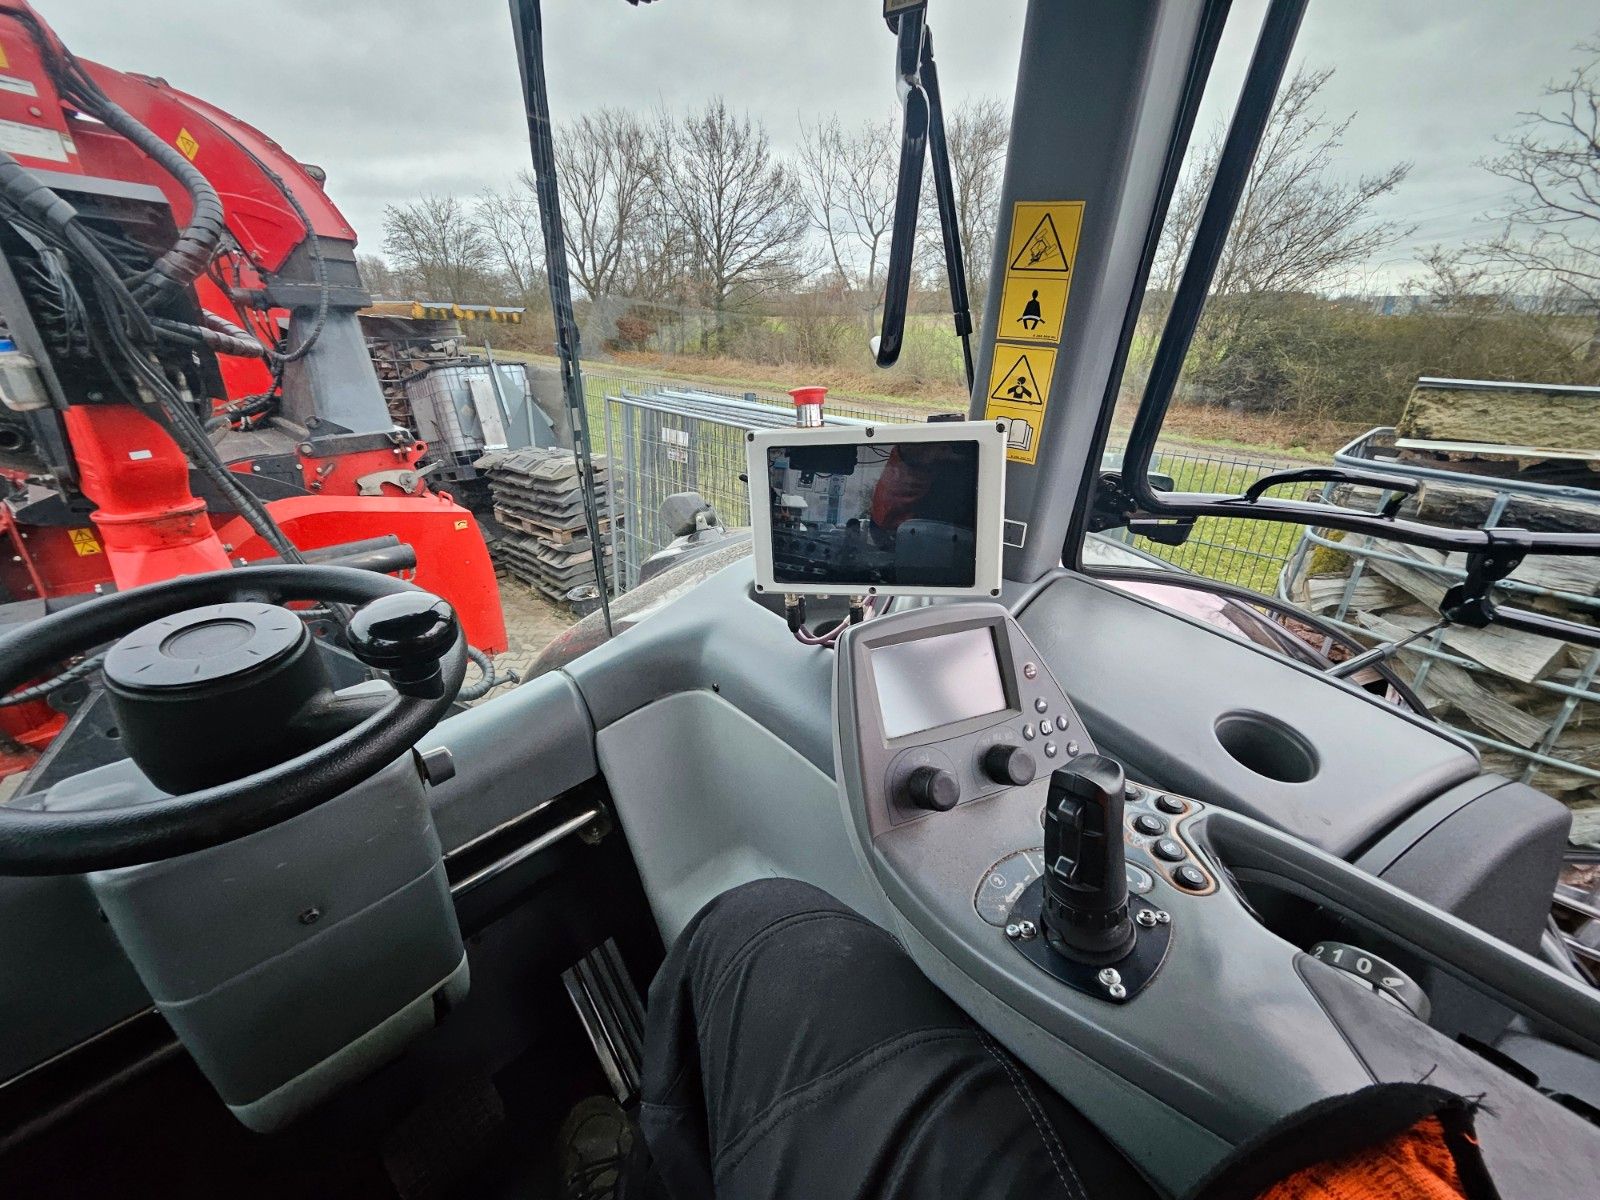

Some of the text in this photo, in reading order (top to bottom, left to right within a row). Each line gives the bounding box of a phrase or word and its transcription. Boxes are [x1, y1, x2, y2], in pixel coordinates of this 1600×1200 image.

[1041, 720, 1053, 734] OK
[1313, 946, 1373, 974] 2 1 0
